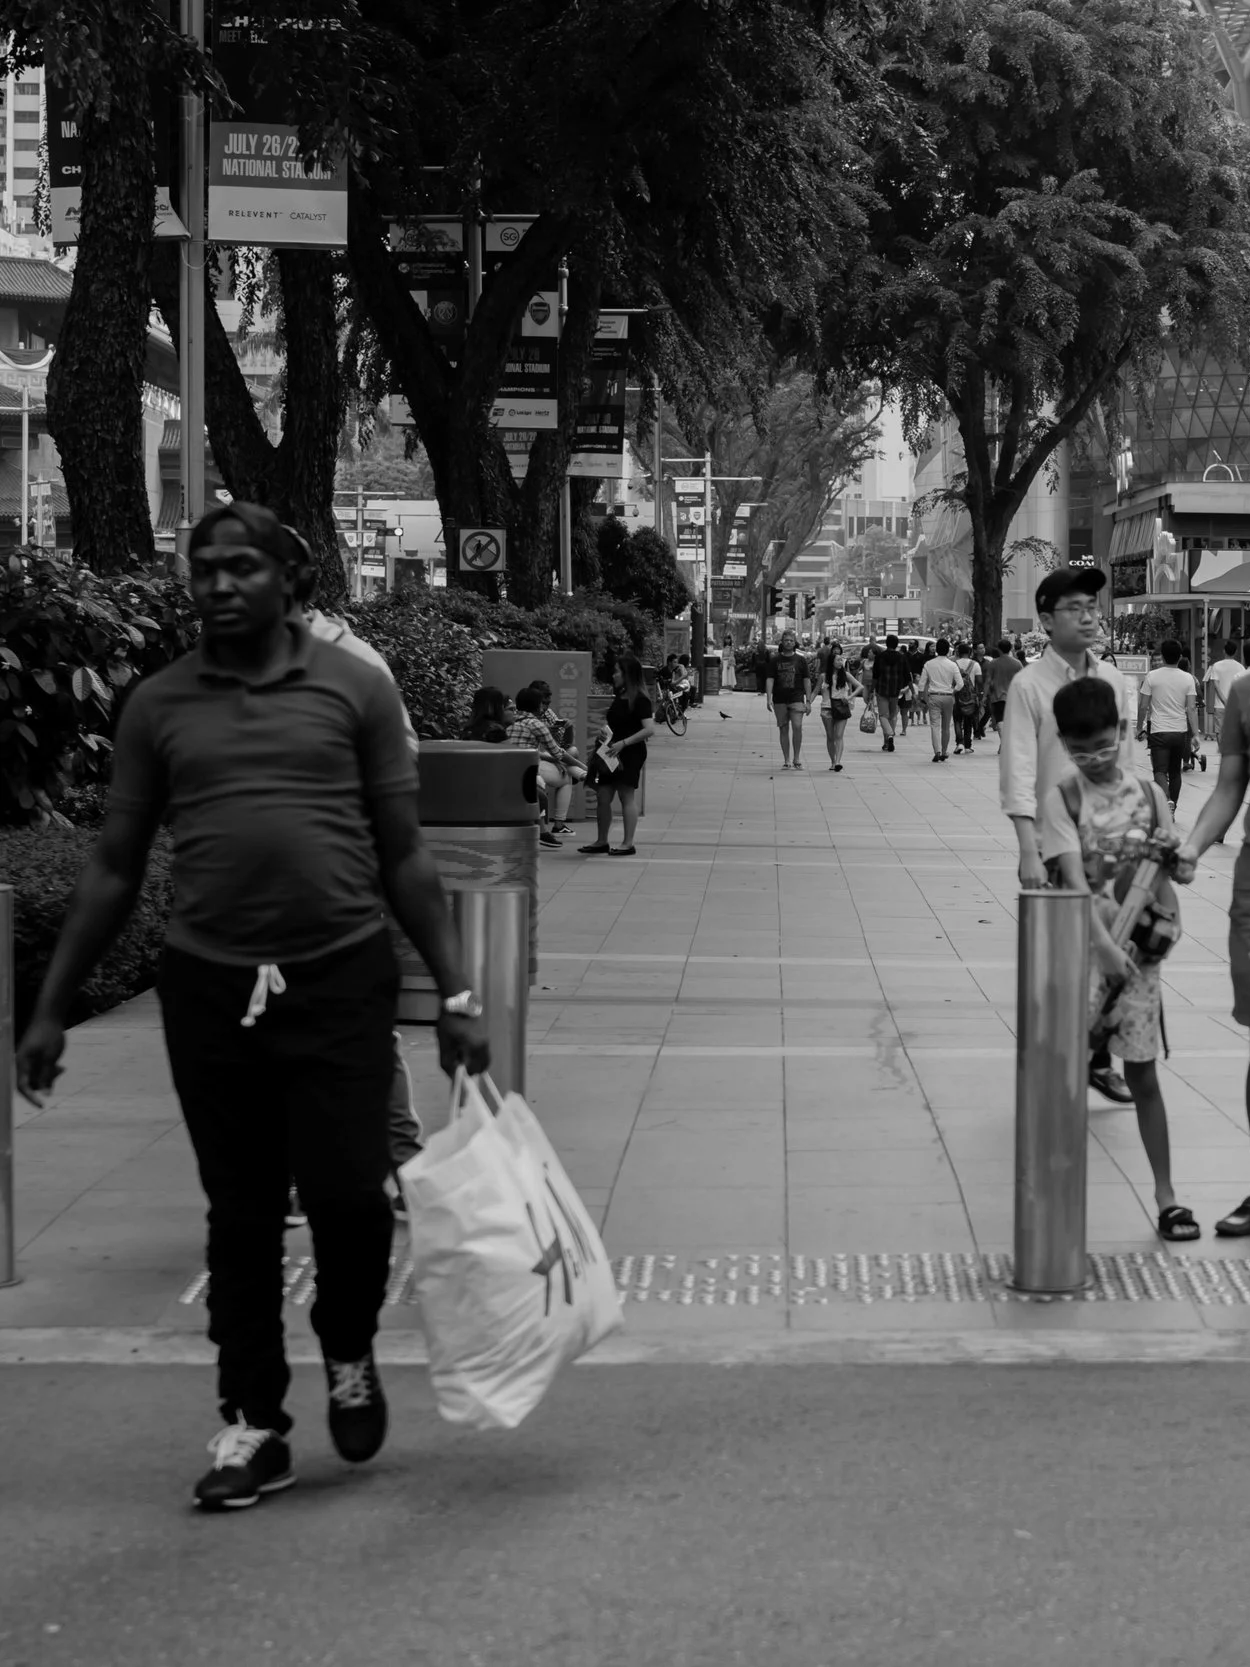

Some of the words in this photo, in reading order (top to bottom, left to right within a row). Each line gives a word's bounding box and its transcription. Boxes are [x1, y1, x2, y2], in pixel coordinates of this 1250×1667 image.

[224, 133, 259, 155] JULY
[262, 135, 303, 158] 26/2
[222, 158, 279, 178] NATIONAL
[228, 209, 279, 219] RELEVENT
[289, 212, 327, 221] CATALYST
[502, 232, 517, 241] SG
